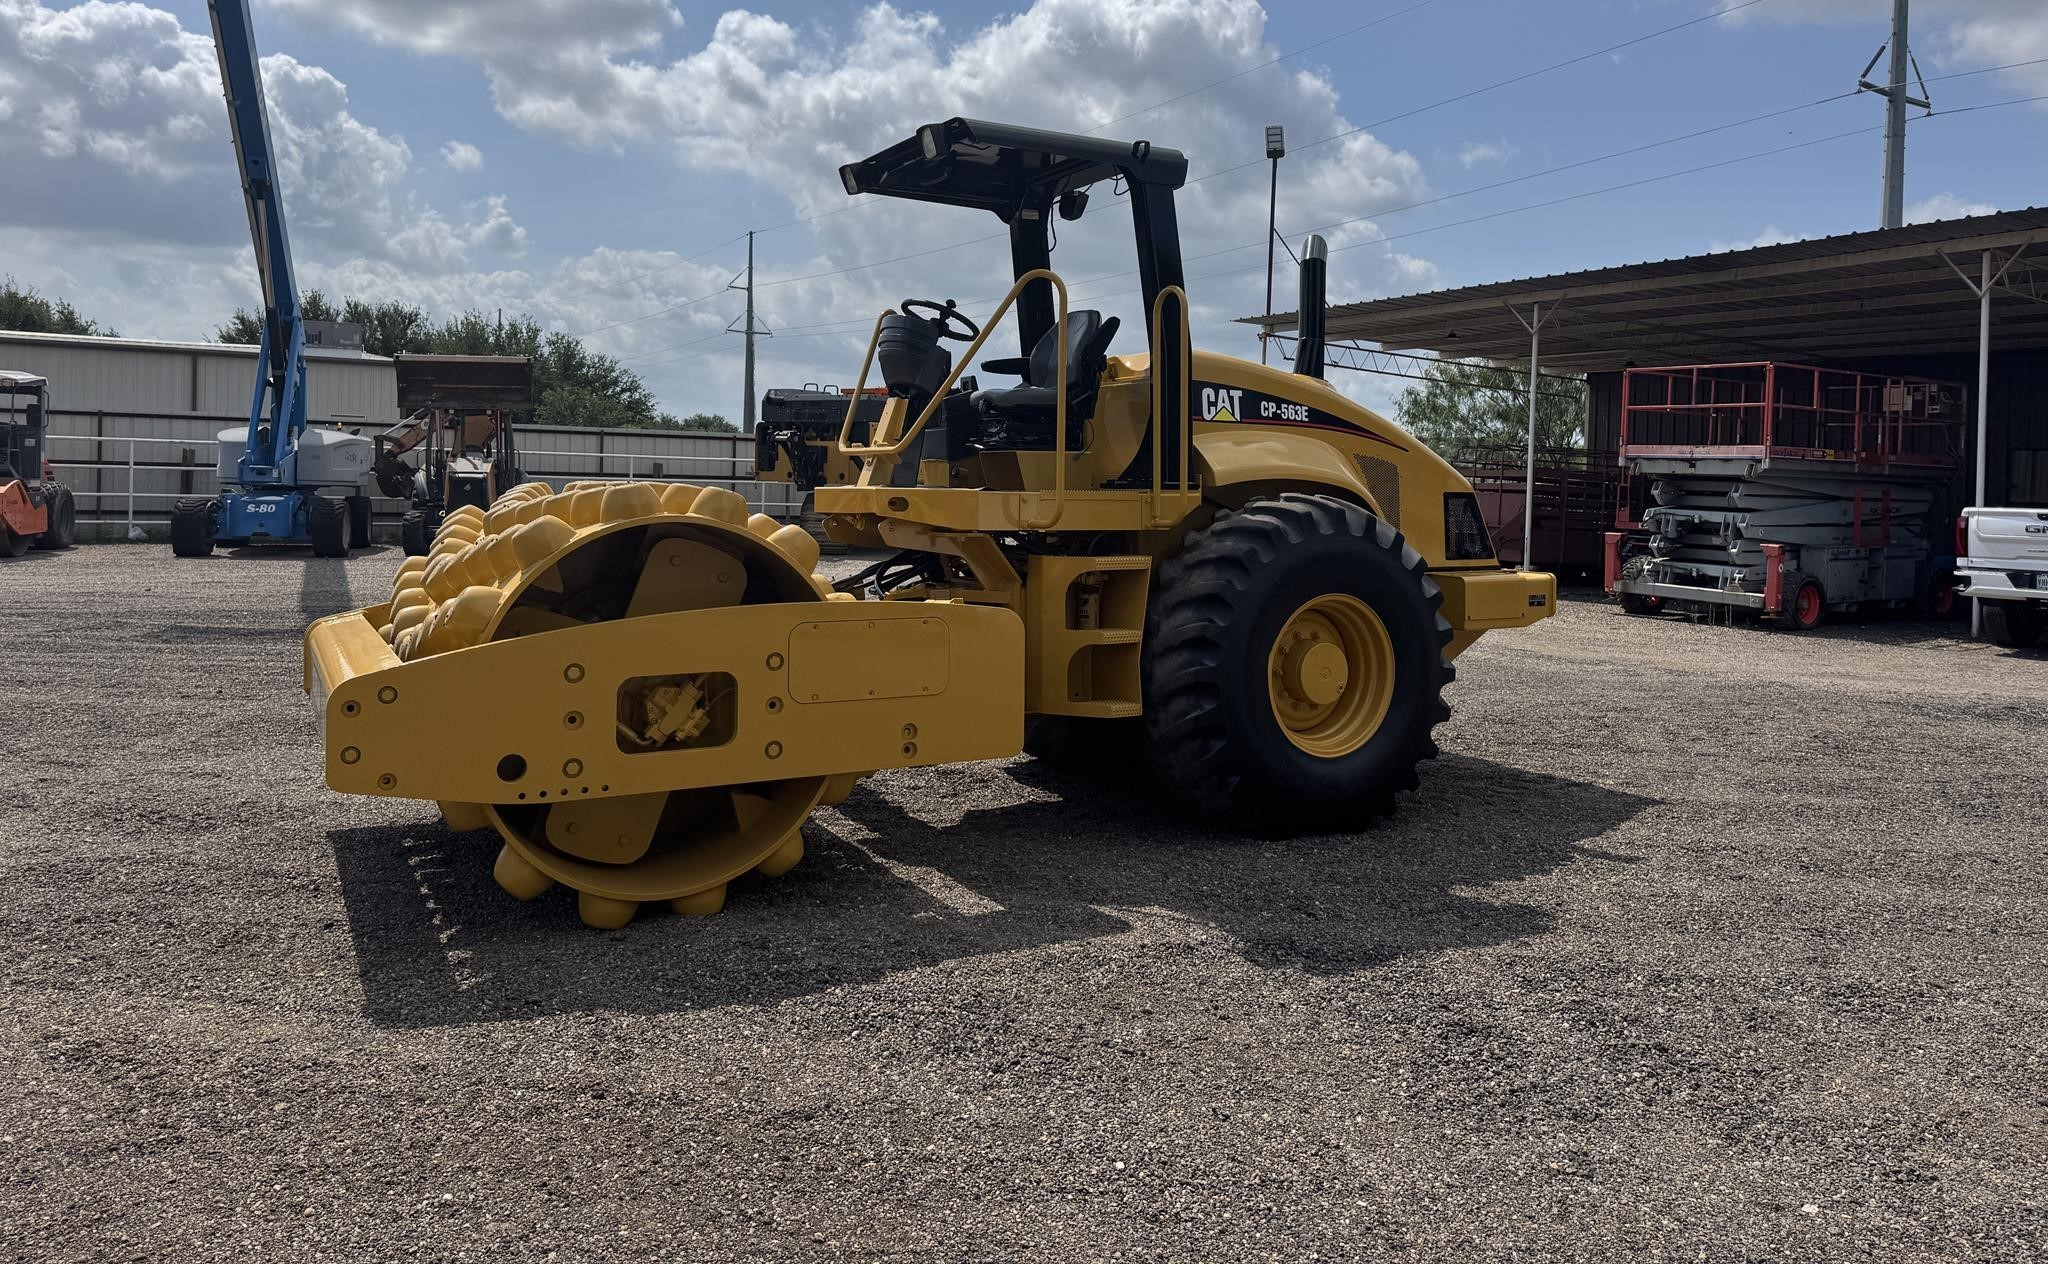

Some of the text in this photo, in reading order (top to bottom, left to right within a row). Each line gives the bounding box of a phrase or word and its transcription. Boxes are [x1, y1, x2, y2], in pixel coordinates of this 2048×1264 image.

[1202, 387, 1309, 421] CAT CP-563E
[246, 503, 276, 513] S-80
